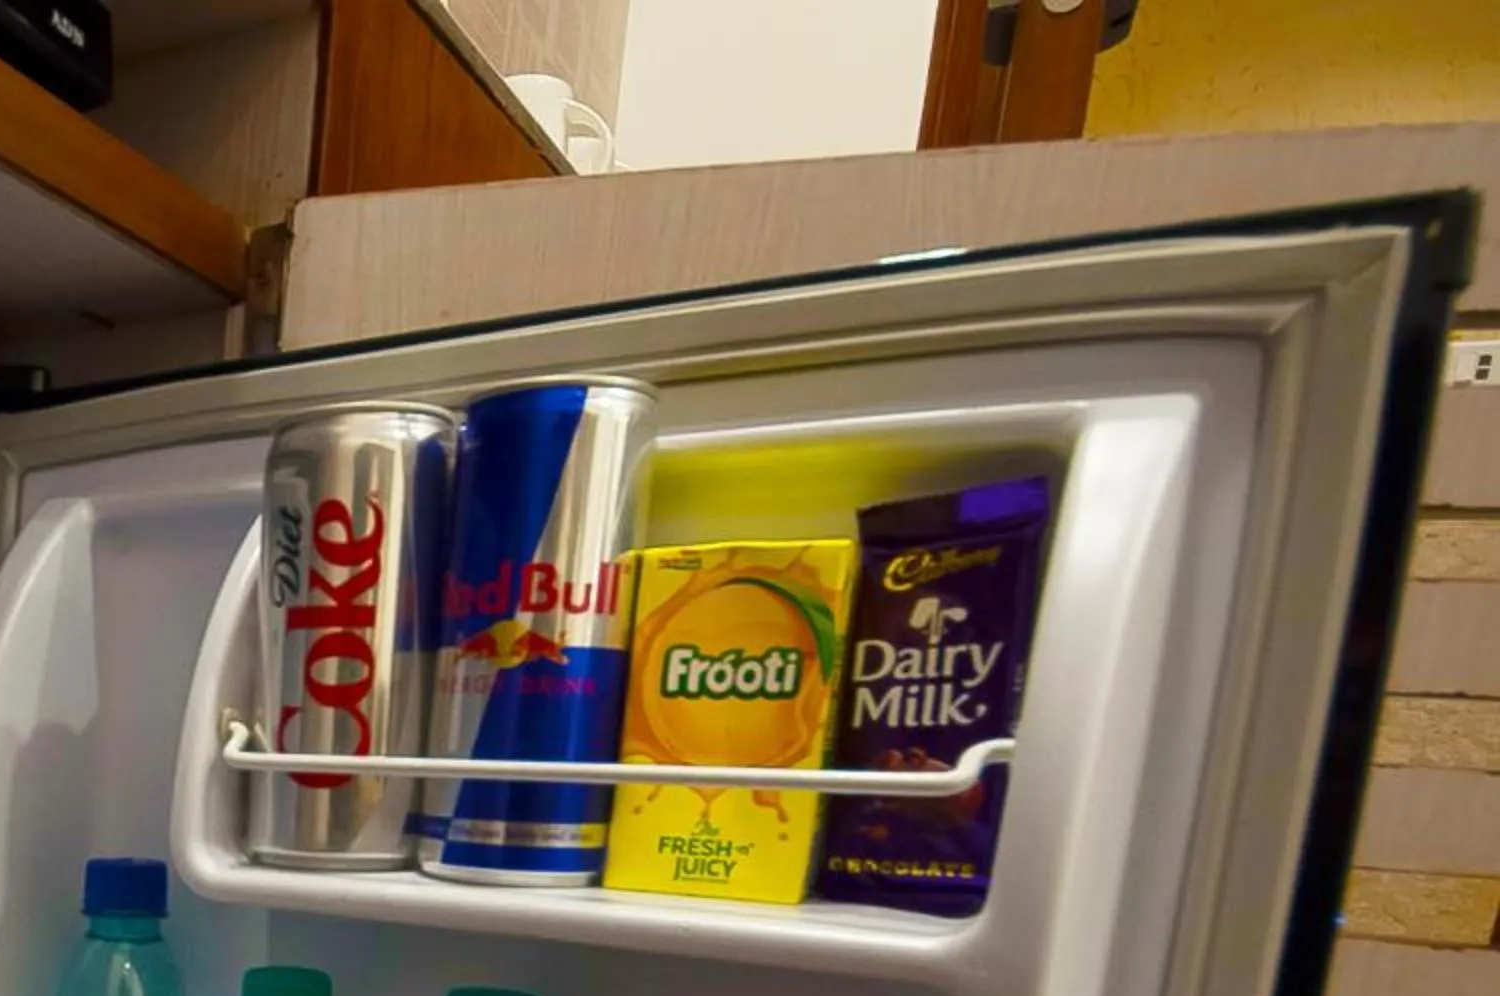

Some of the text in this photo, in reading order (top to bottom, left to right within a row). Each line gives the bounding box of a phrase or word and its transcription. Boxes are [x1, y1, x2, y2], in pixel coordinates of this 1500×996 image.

[271, 504, 303, 608] Diet
[519, 562, 621, 615] Bull
[276, 499, 384, 789] Coke
[852, 640, 1004, 688] Dairy
[852, 683, 979, 729] Milk
[658, 836, 733, 857] FRESH
[673, 856, 738, 881] JUICY
